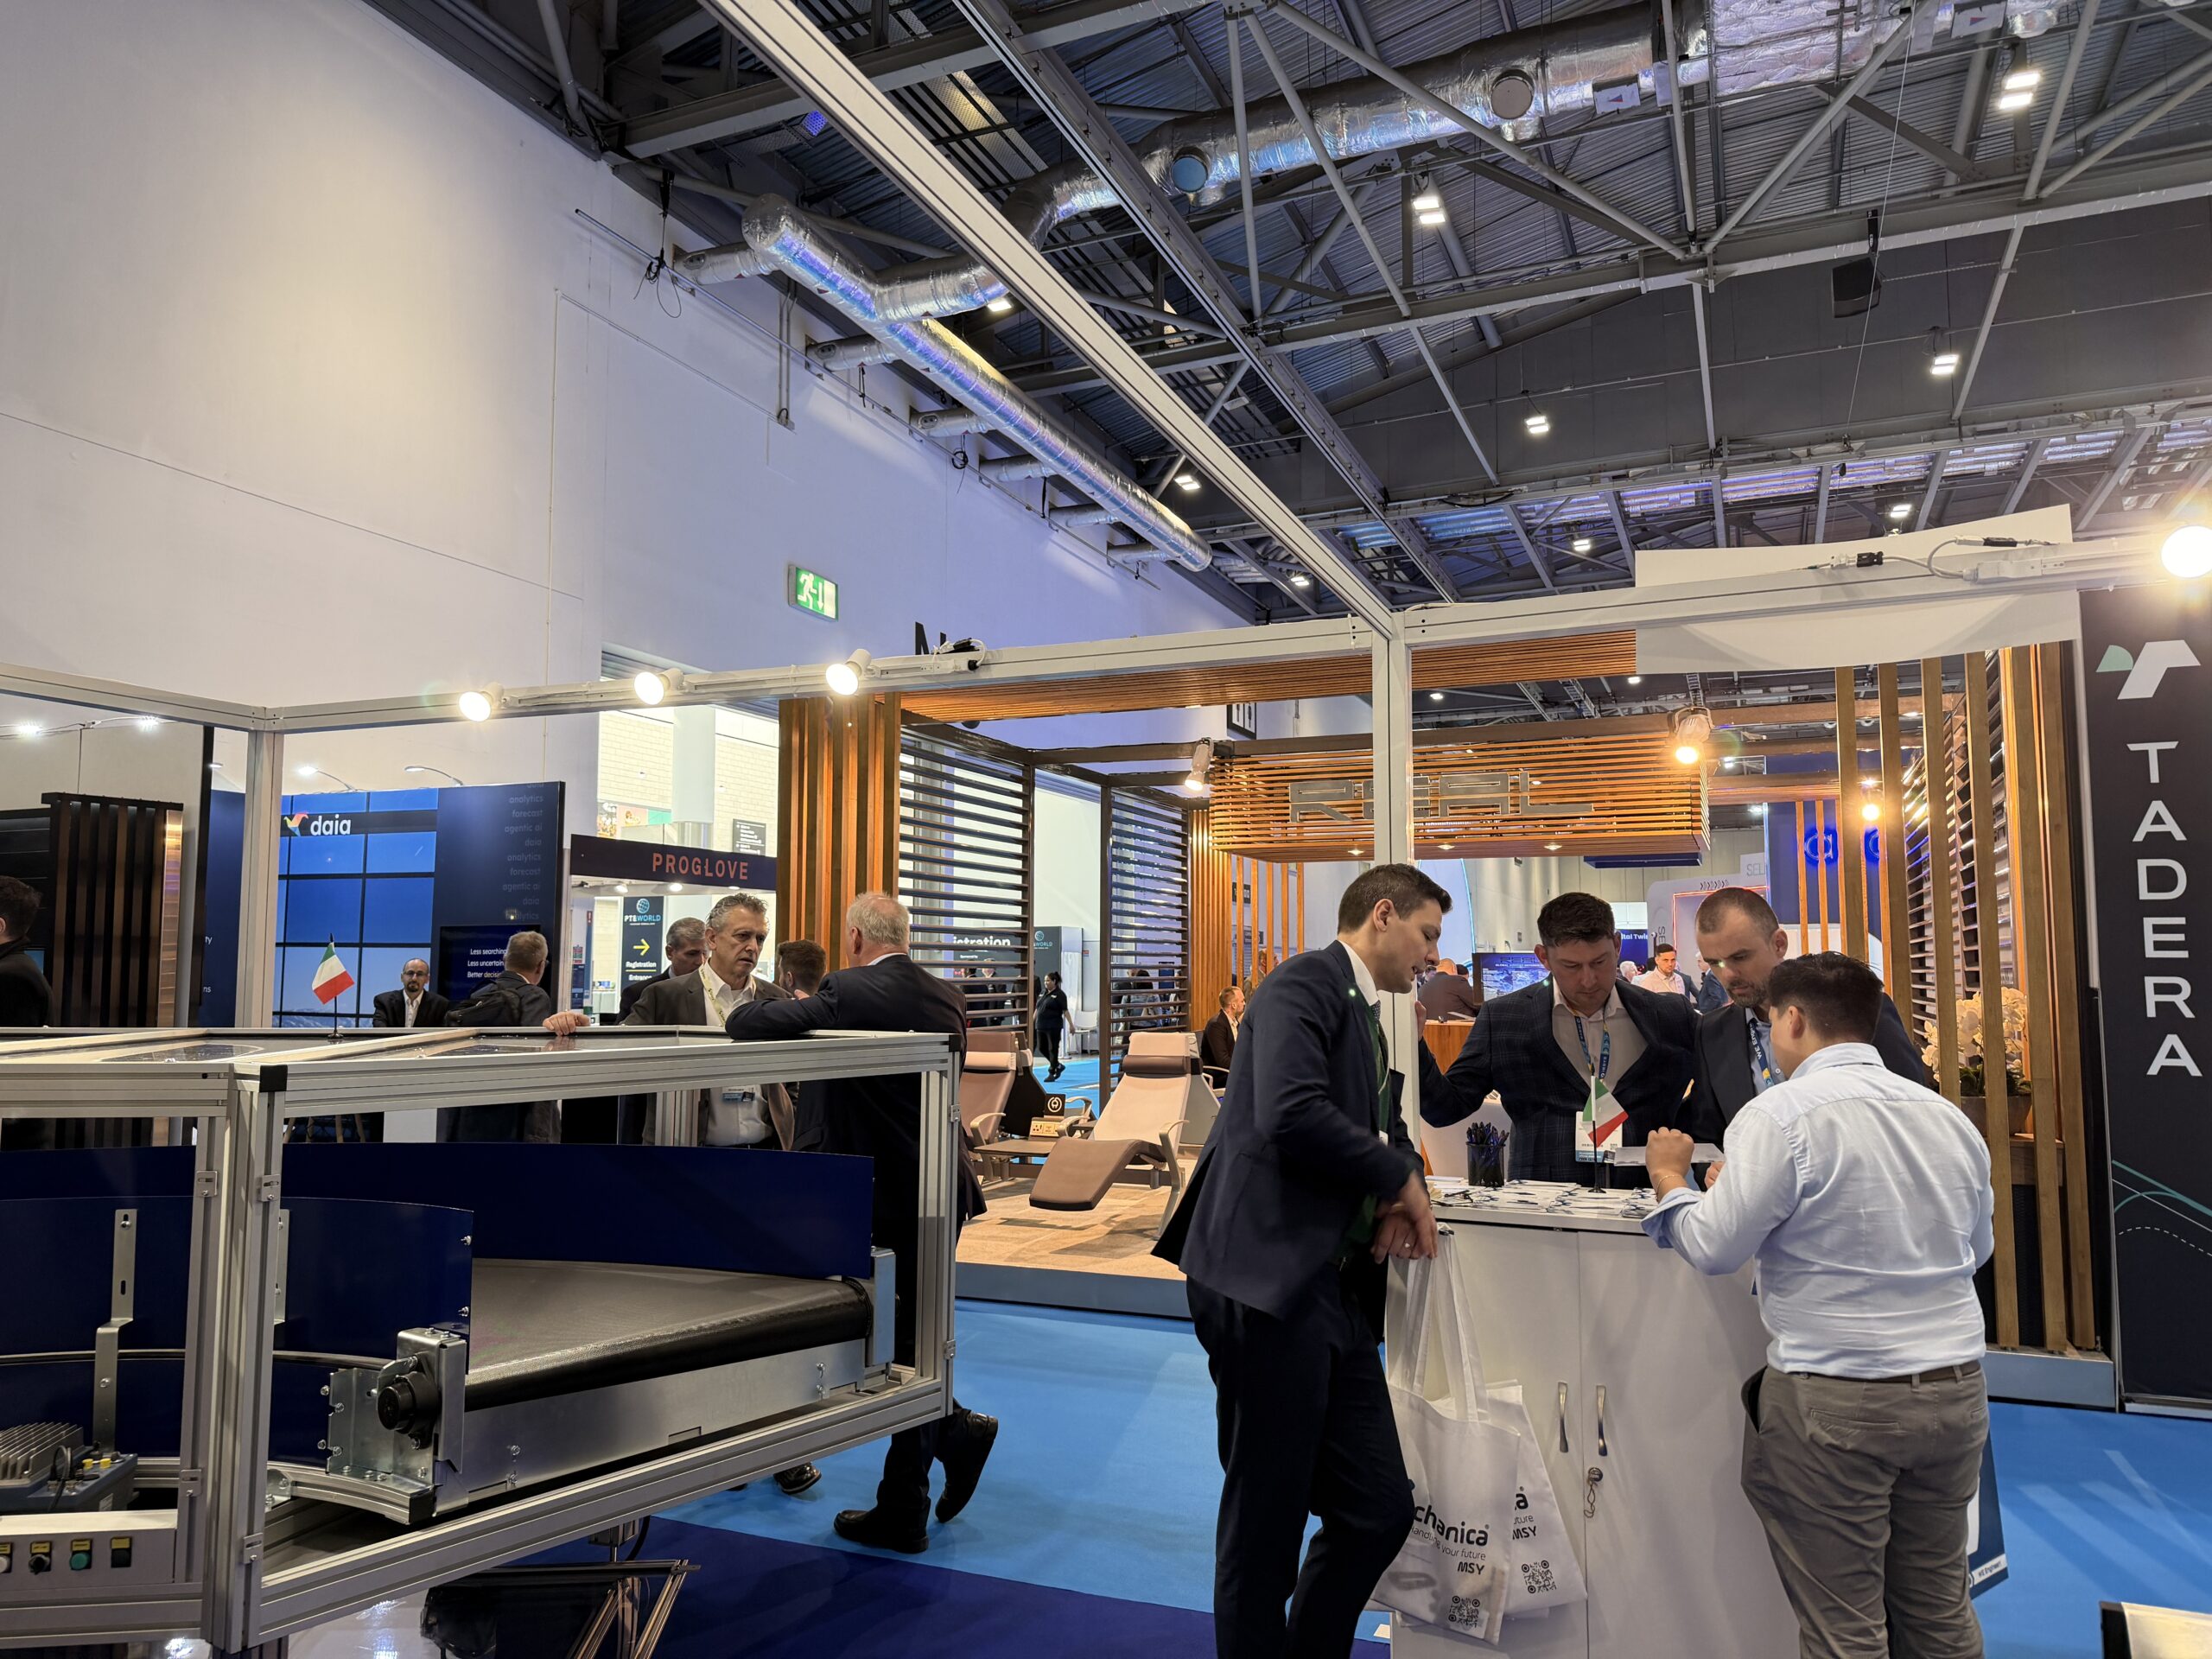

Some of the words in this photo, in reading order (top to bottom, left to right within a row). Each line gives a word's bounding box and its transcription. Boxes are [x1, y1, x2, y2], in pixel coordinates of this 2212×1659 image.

[509, 794, 543, 805] analytics
[512, 809, 543, 817] forecast
[310, 814, 352, 836] daia
[505, 824, 533, 835] agentic
[507, 854, 541, 864] analytics
[652, 852, 748, 880] PROGLOVE
[510, 868, 541, 876] forecast
[503, 882, 531, 892] agentic
[2126, 741, 2203, 1077] TADERA
[505, 912, 539, 923] alytics
[953, 935, 1011, 946] istration
[1441, 1546, 1459, 1556] your
[1460, 1548, 1486, 1560] future
[1457, 1561, 1485, 1575] MSY
